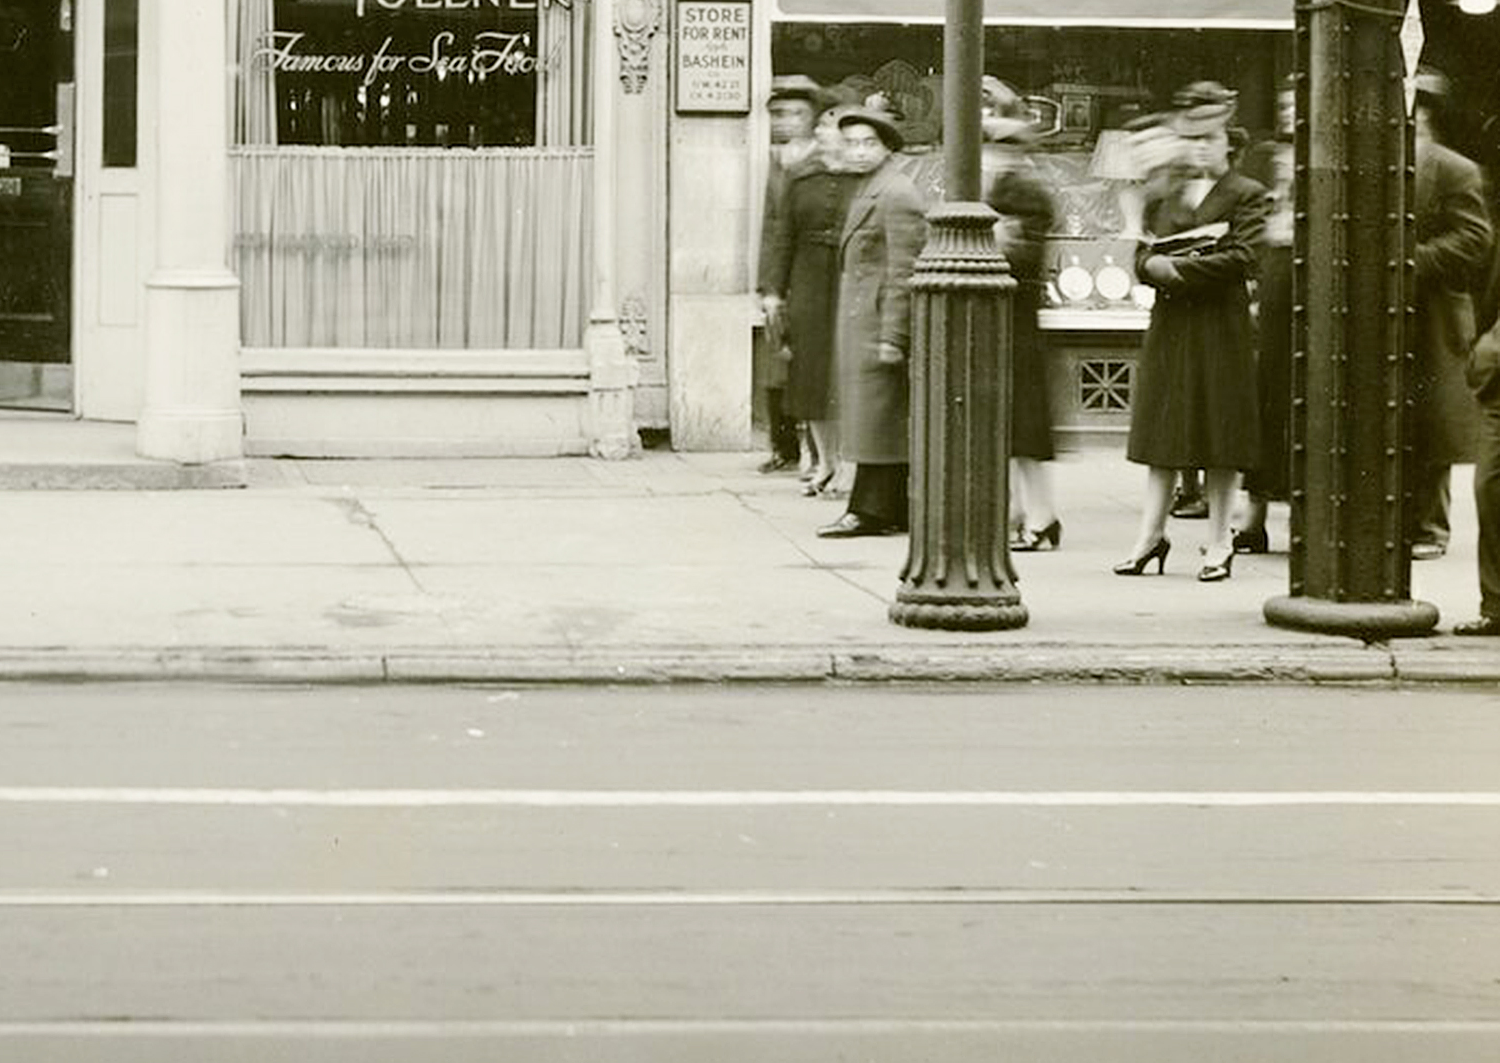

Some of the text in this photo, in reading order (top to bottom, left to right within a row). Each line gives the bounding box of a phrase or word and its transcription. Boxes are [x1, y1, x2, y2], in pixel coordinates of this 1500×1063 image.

[685, 7, 746, 24] STORE
[682, 26, 747, 41] FOR RENT
[252, 31, 365, 73] Famous
[362, 36, 403, 86] for
[407, 32, 468, 74] Sea
[682, 54, 746, 69] BASHEIN
